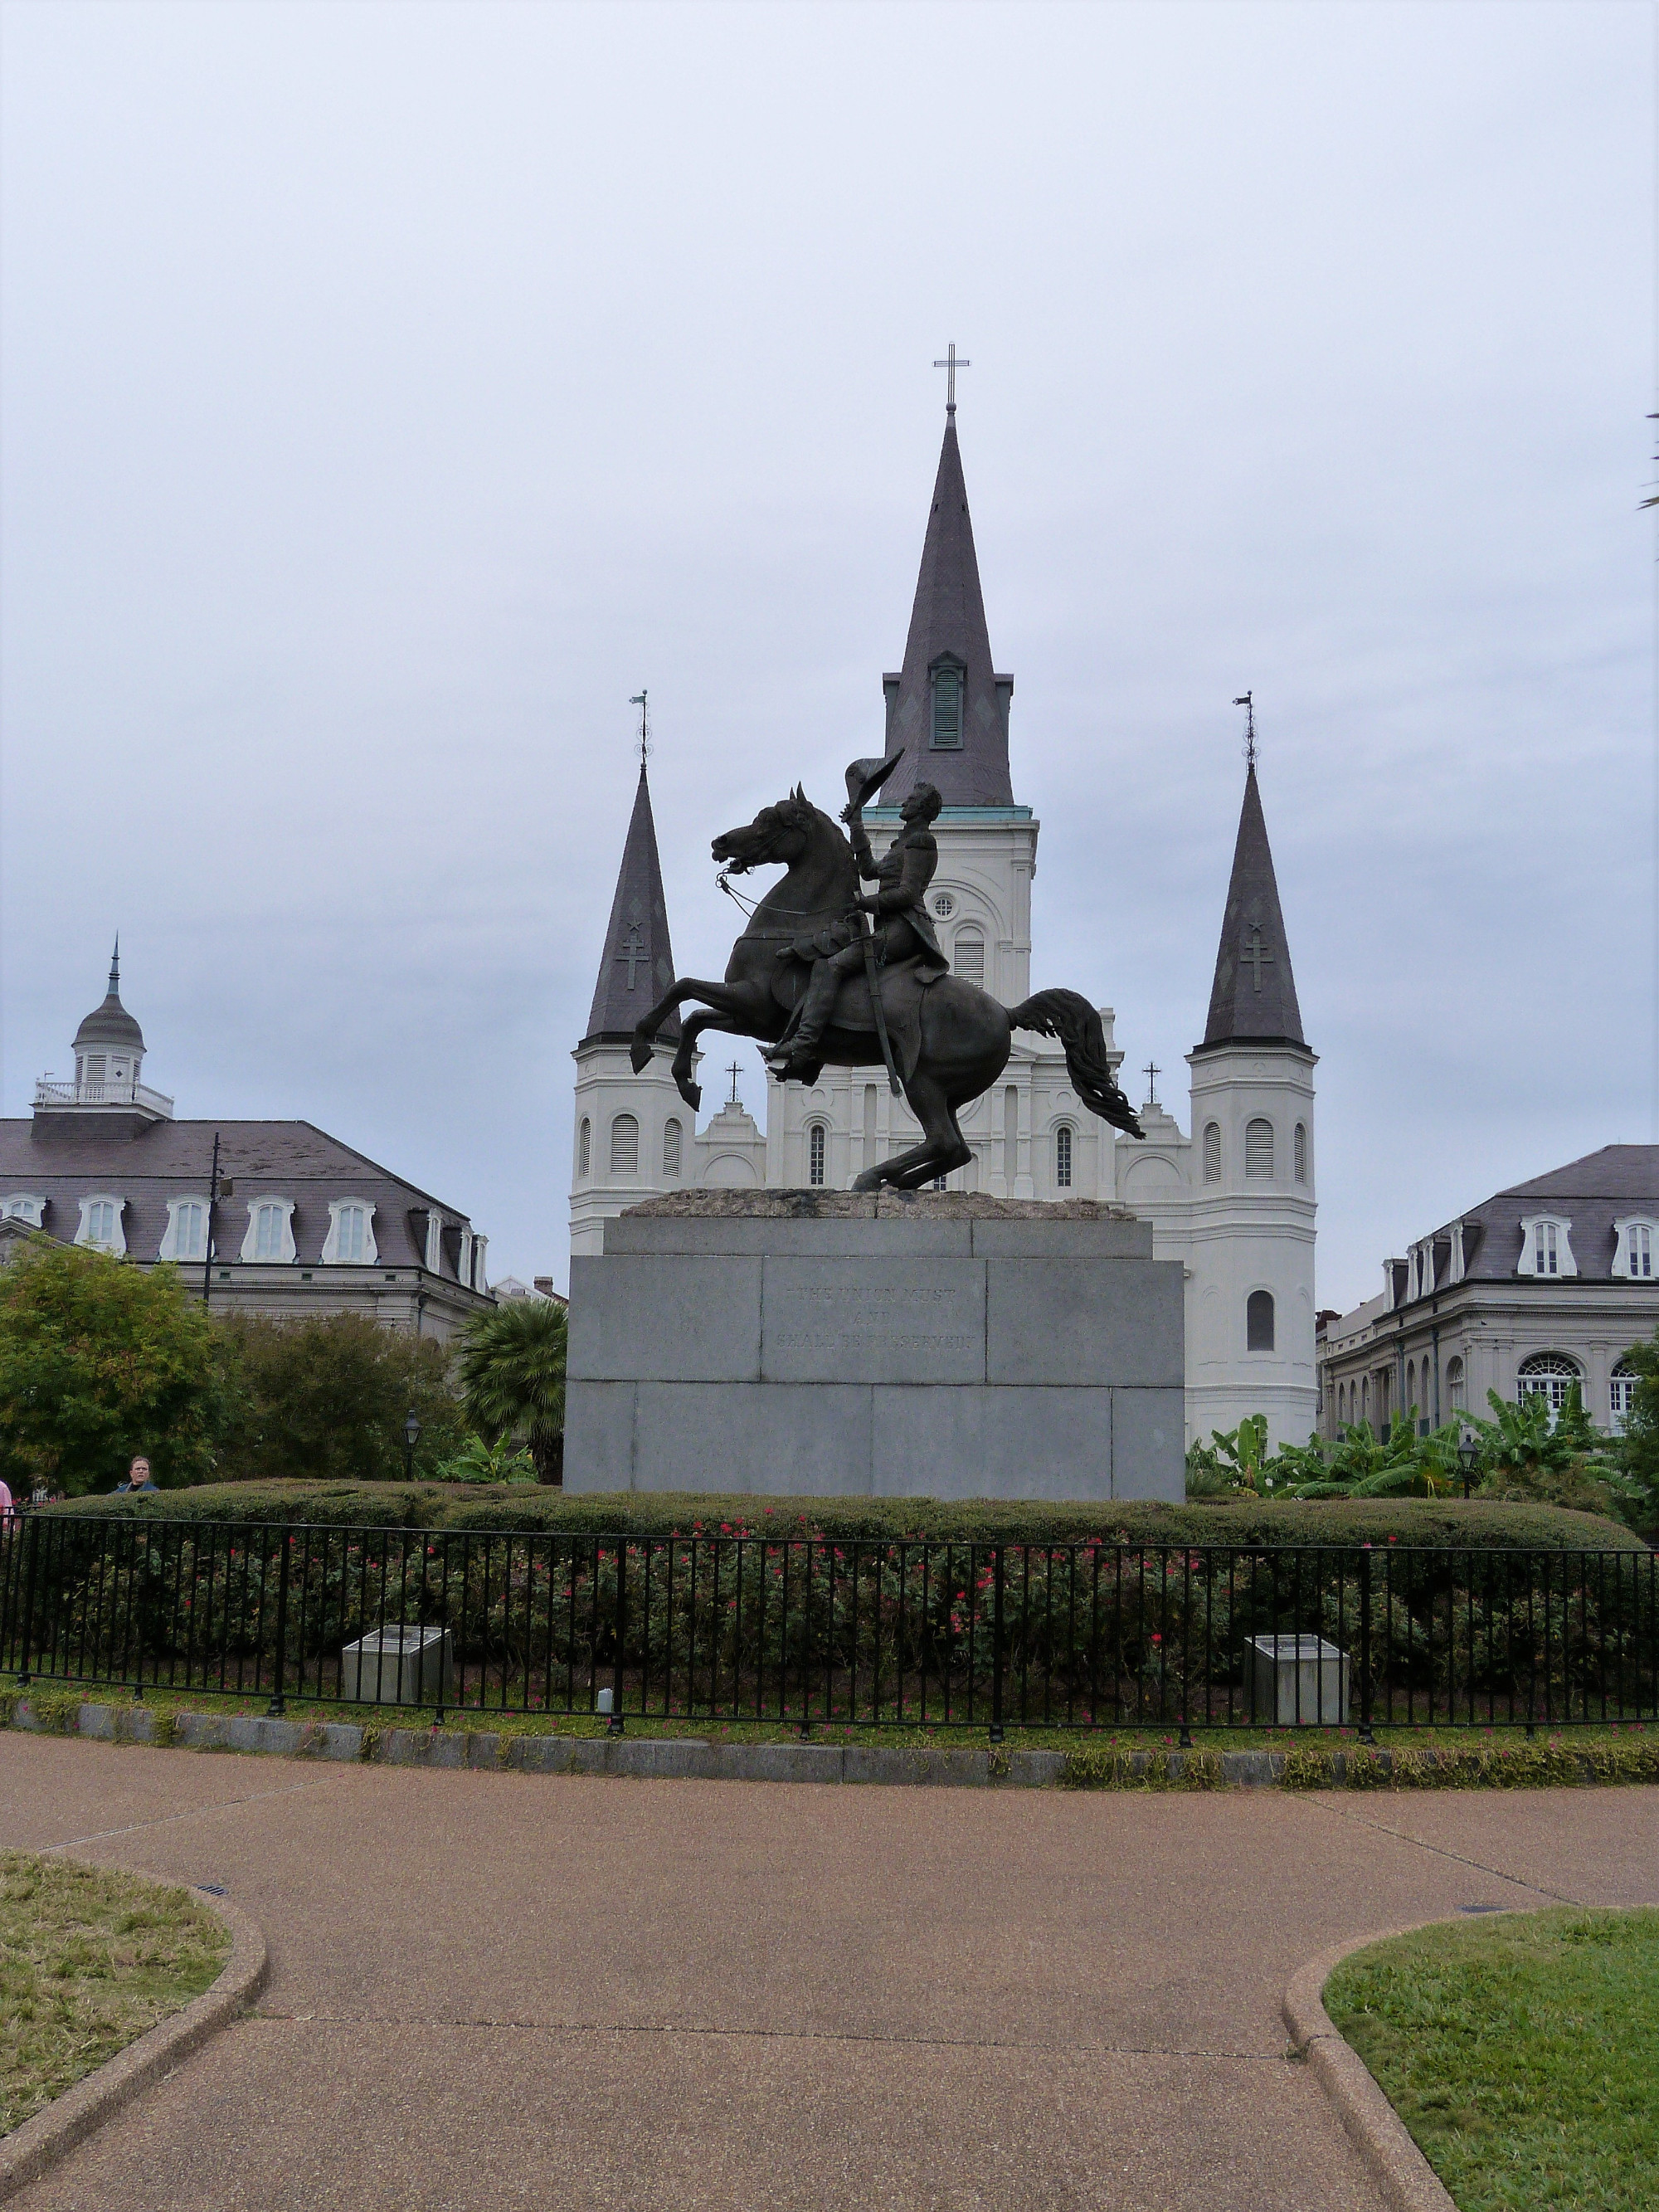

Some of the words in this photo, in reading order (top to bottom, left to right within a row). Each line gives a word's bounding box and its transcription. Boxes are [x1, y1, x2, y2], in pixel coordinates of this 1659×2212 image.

[838, 1288, 896, 1303] UNION
[902, 1289, 956, 1303] MUST
[852, 1311, 893, 1325] AND
[776, 1333, 834, 1349] SHALL
[839, 1333, 862, 1349] BE
